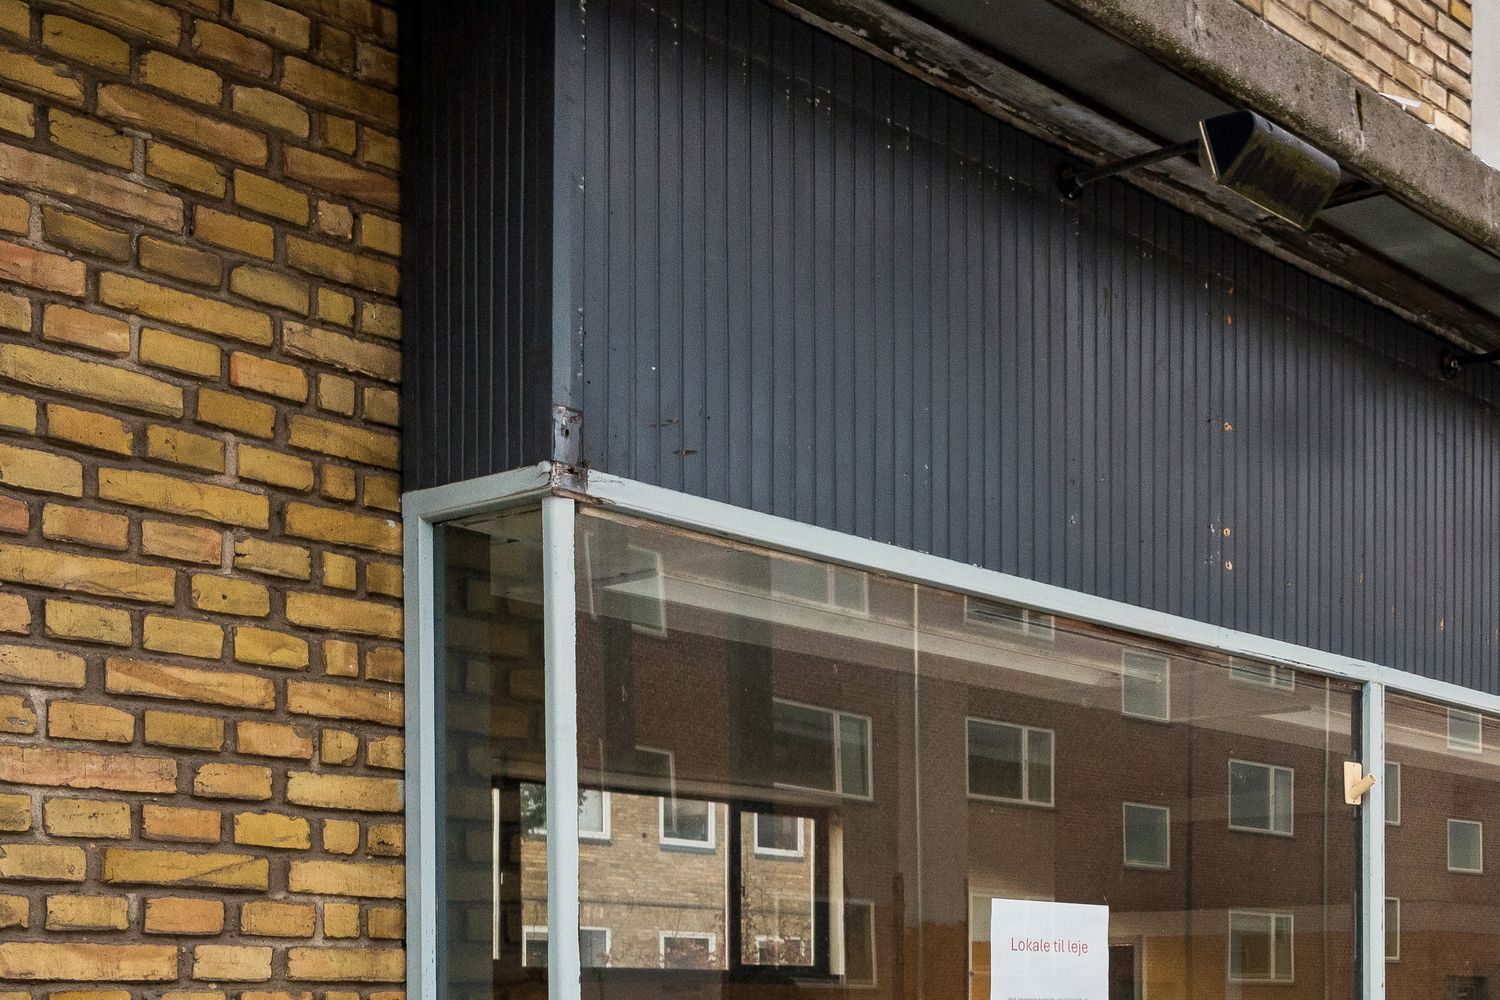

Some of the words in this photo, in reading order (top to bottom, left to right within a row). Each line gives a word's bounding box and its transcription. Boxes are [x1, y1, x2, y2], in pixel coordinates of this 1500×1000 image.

[1011, 937, 1050, 952] Lokale
[1053, 939, 1065, 953] til
[1067, 939, 1089, 957] leje
